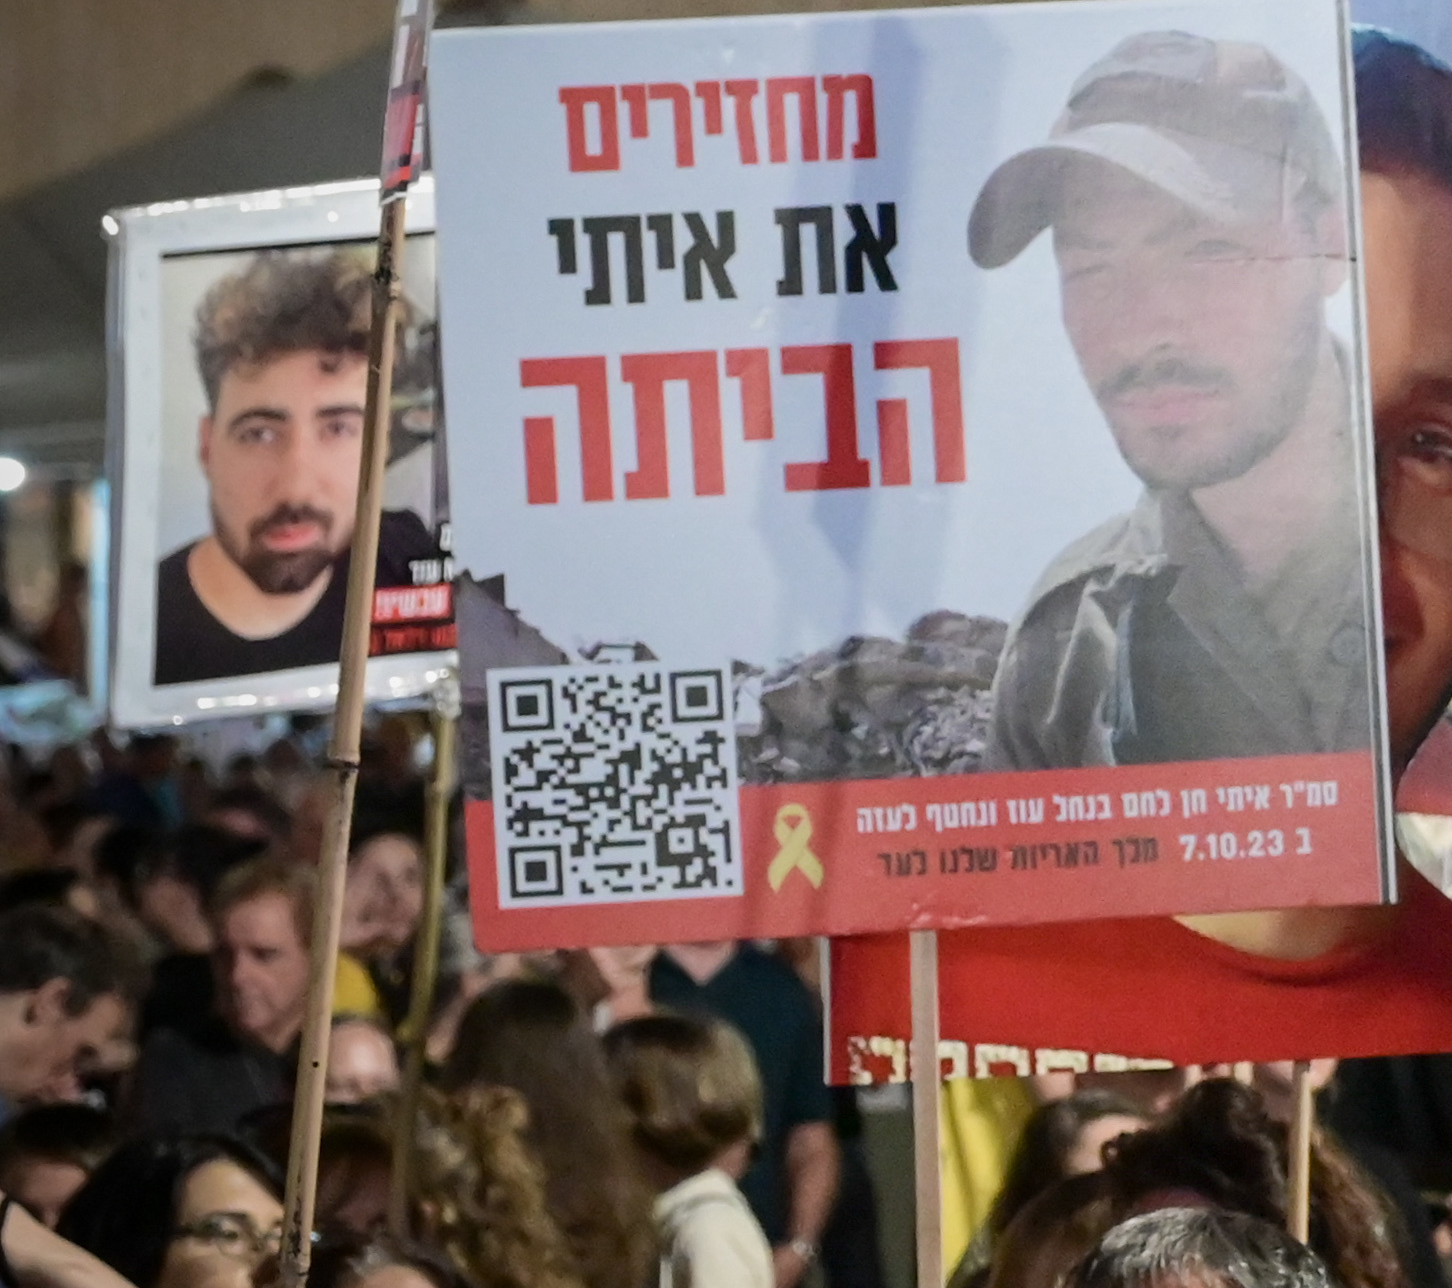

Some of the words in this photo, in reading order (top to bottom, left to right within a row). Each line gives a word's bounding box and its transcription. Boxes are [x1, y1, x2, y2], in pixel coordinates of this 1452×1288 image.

[558, 72, 878, 172] מחזירים
[548, 210, 738, 306] איתי
[774, 202, 898, 297] את
[520, 336, 966, 505] הביתה
[1007, 796, 1044, 825] עוז
[1053, 792, 1112, 822] בנחל
[1123, 789, 1170, 819] לחם
[1181, 788, 1208, 817] חן
[1216, 785, 1271, 813] איתי
[856, 802, 917, 834] לעזה
[926, 800, 998, 833] ונחטף
[1178, 831, 1285, 861] 7.10.23
[1296, 827, 1312, 855] ב
[939, 845, 997, 874] שלנו
